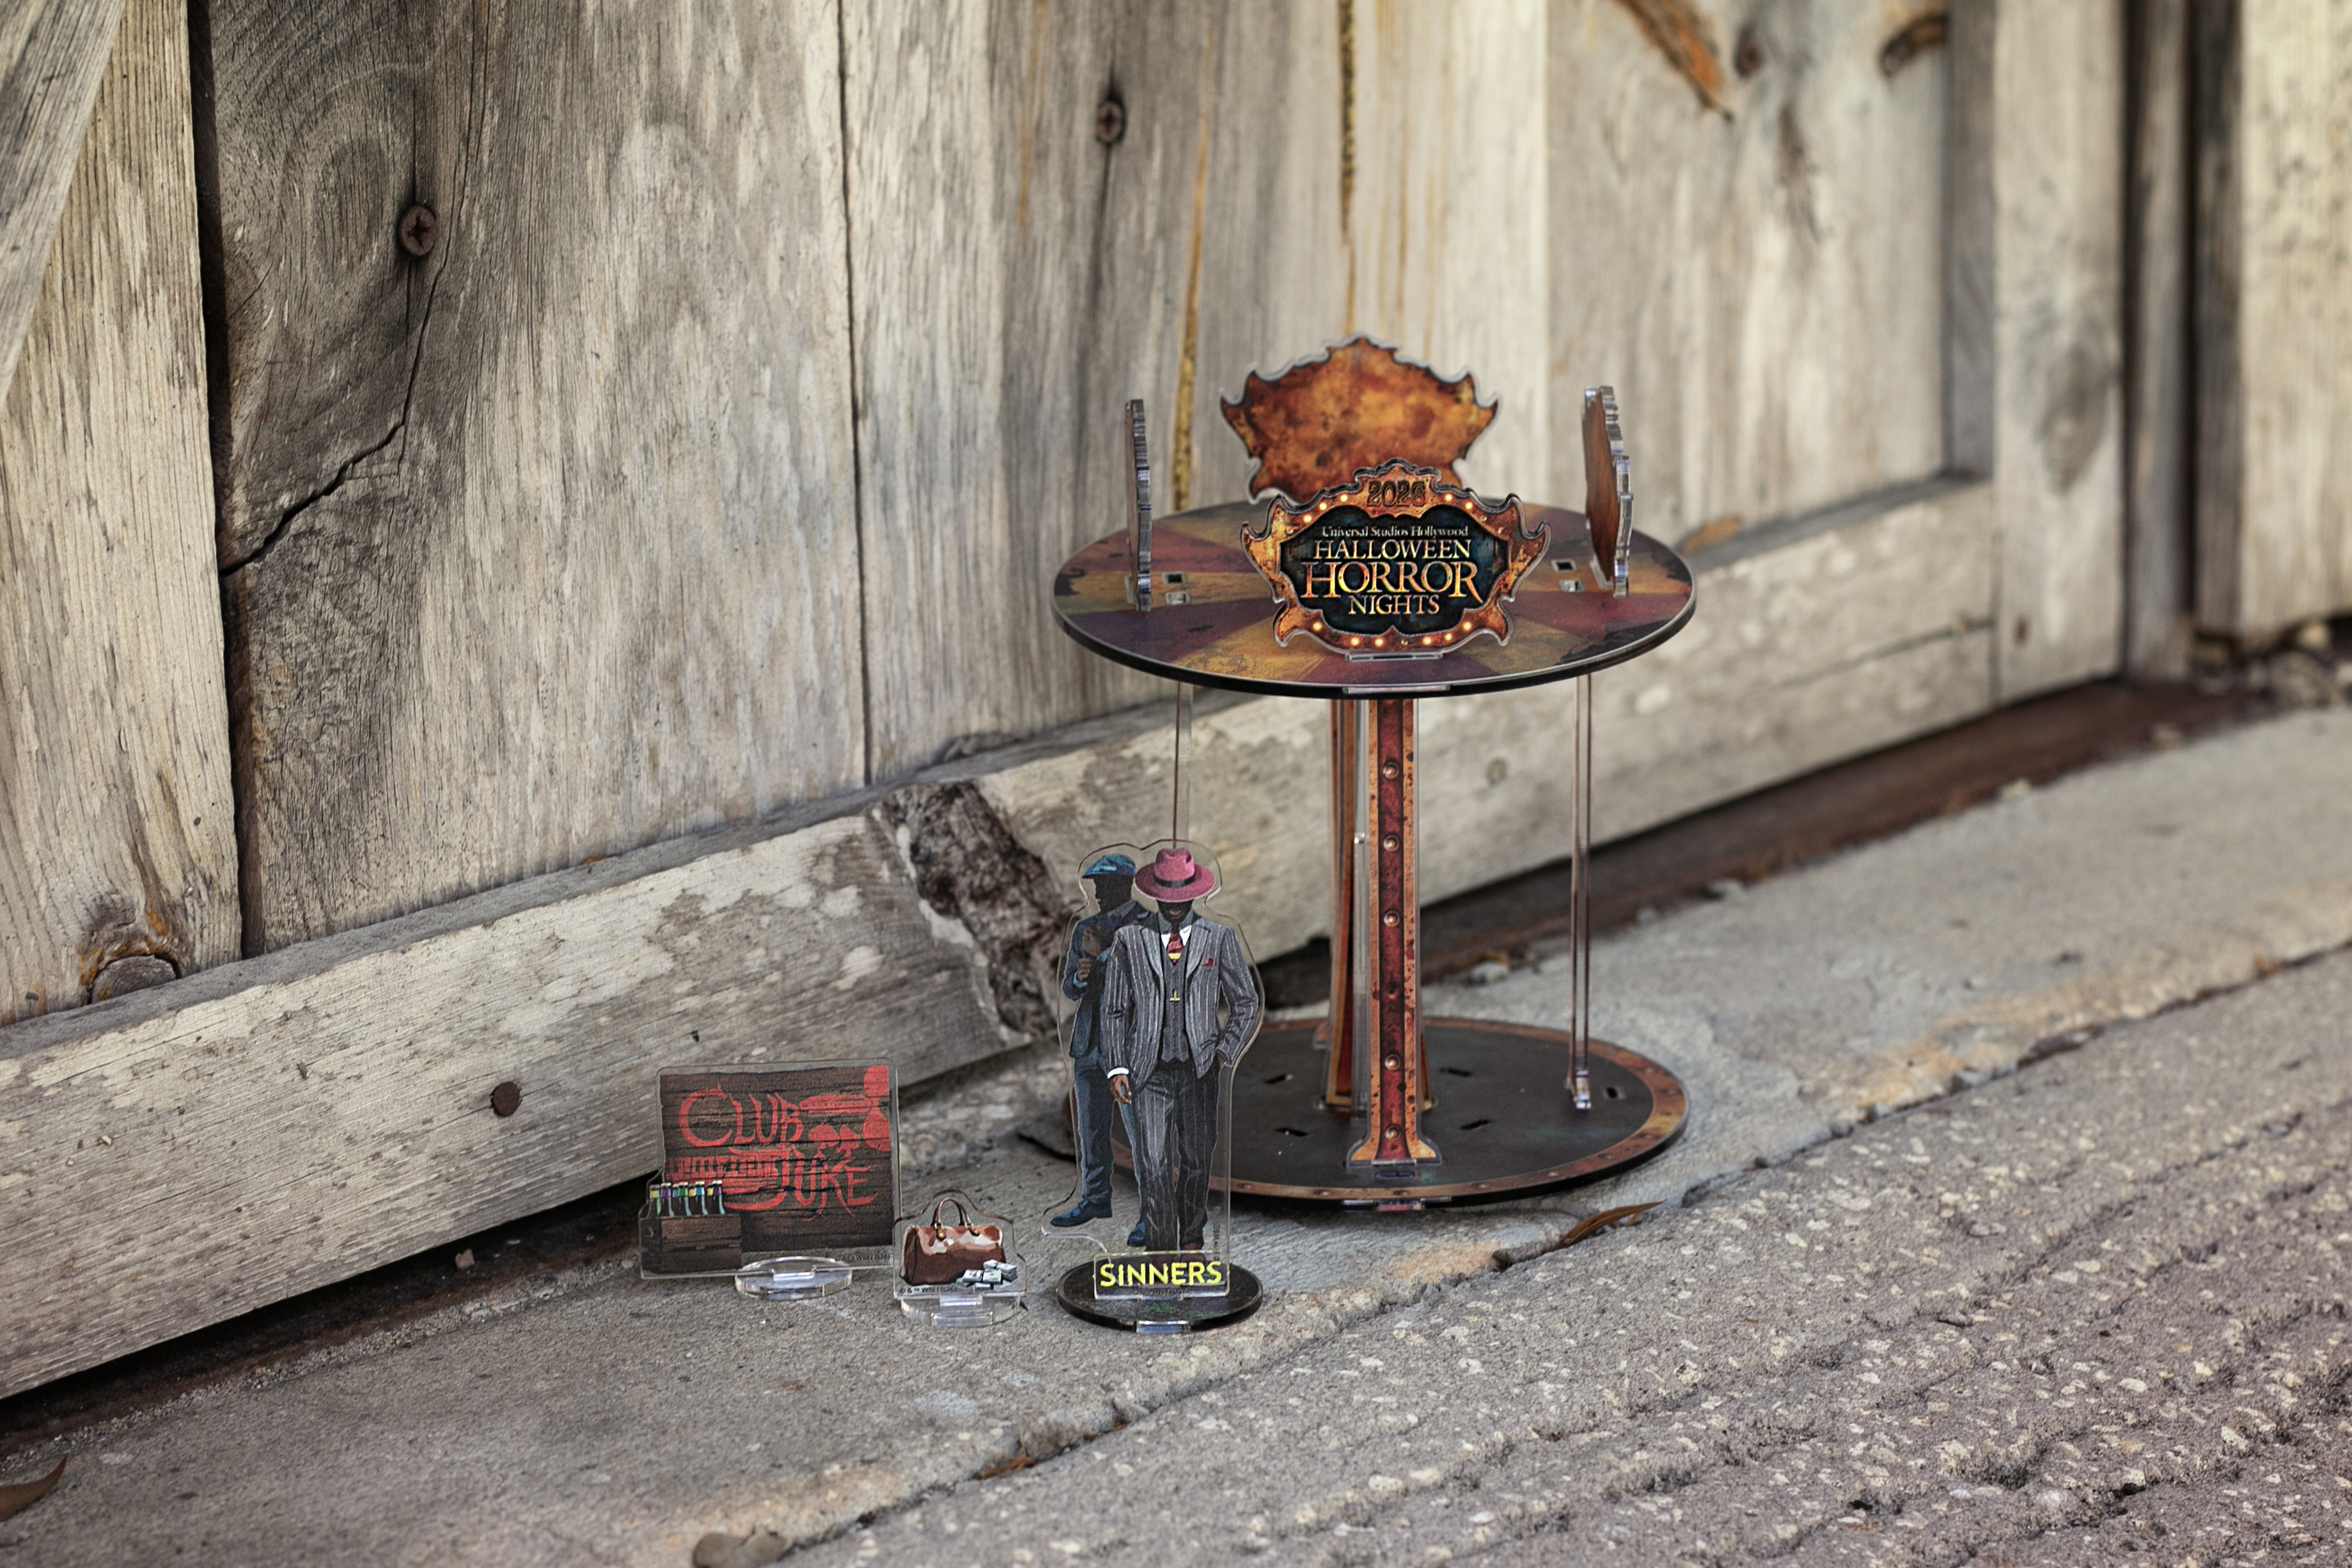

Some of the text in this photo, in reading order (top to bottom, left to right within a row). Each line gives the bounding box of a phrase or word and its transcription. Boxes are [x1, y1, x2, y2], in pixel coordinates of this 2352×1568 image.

[1367, 480, 1426, 507] 2026
[1322, 525, 1469, 539] Universal Studios Hollywood
[1313, 538, 1471, 560] HALLOWEEN
[1300, 560, 1484, 604] HORROR
[1347, 594, 1440, 615] NIGHTS
[678, 1082, 804, 1148] CLUB
[1100, 1261, 1222, 1287] SINNERS
